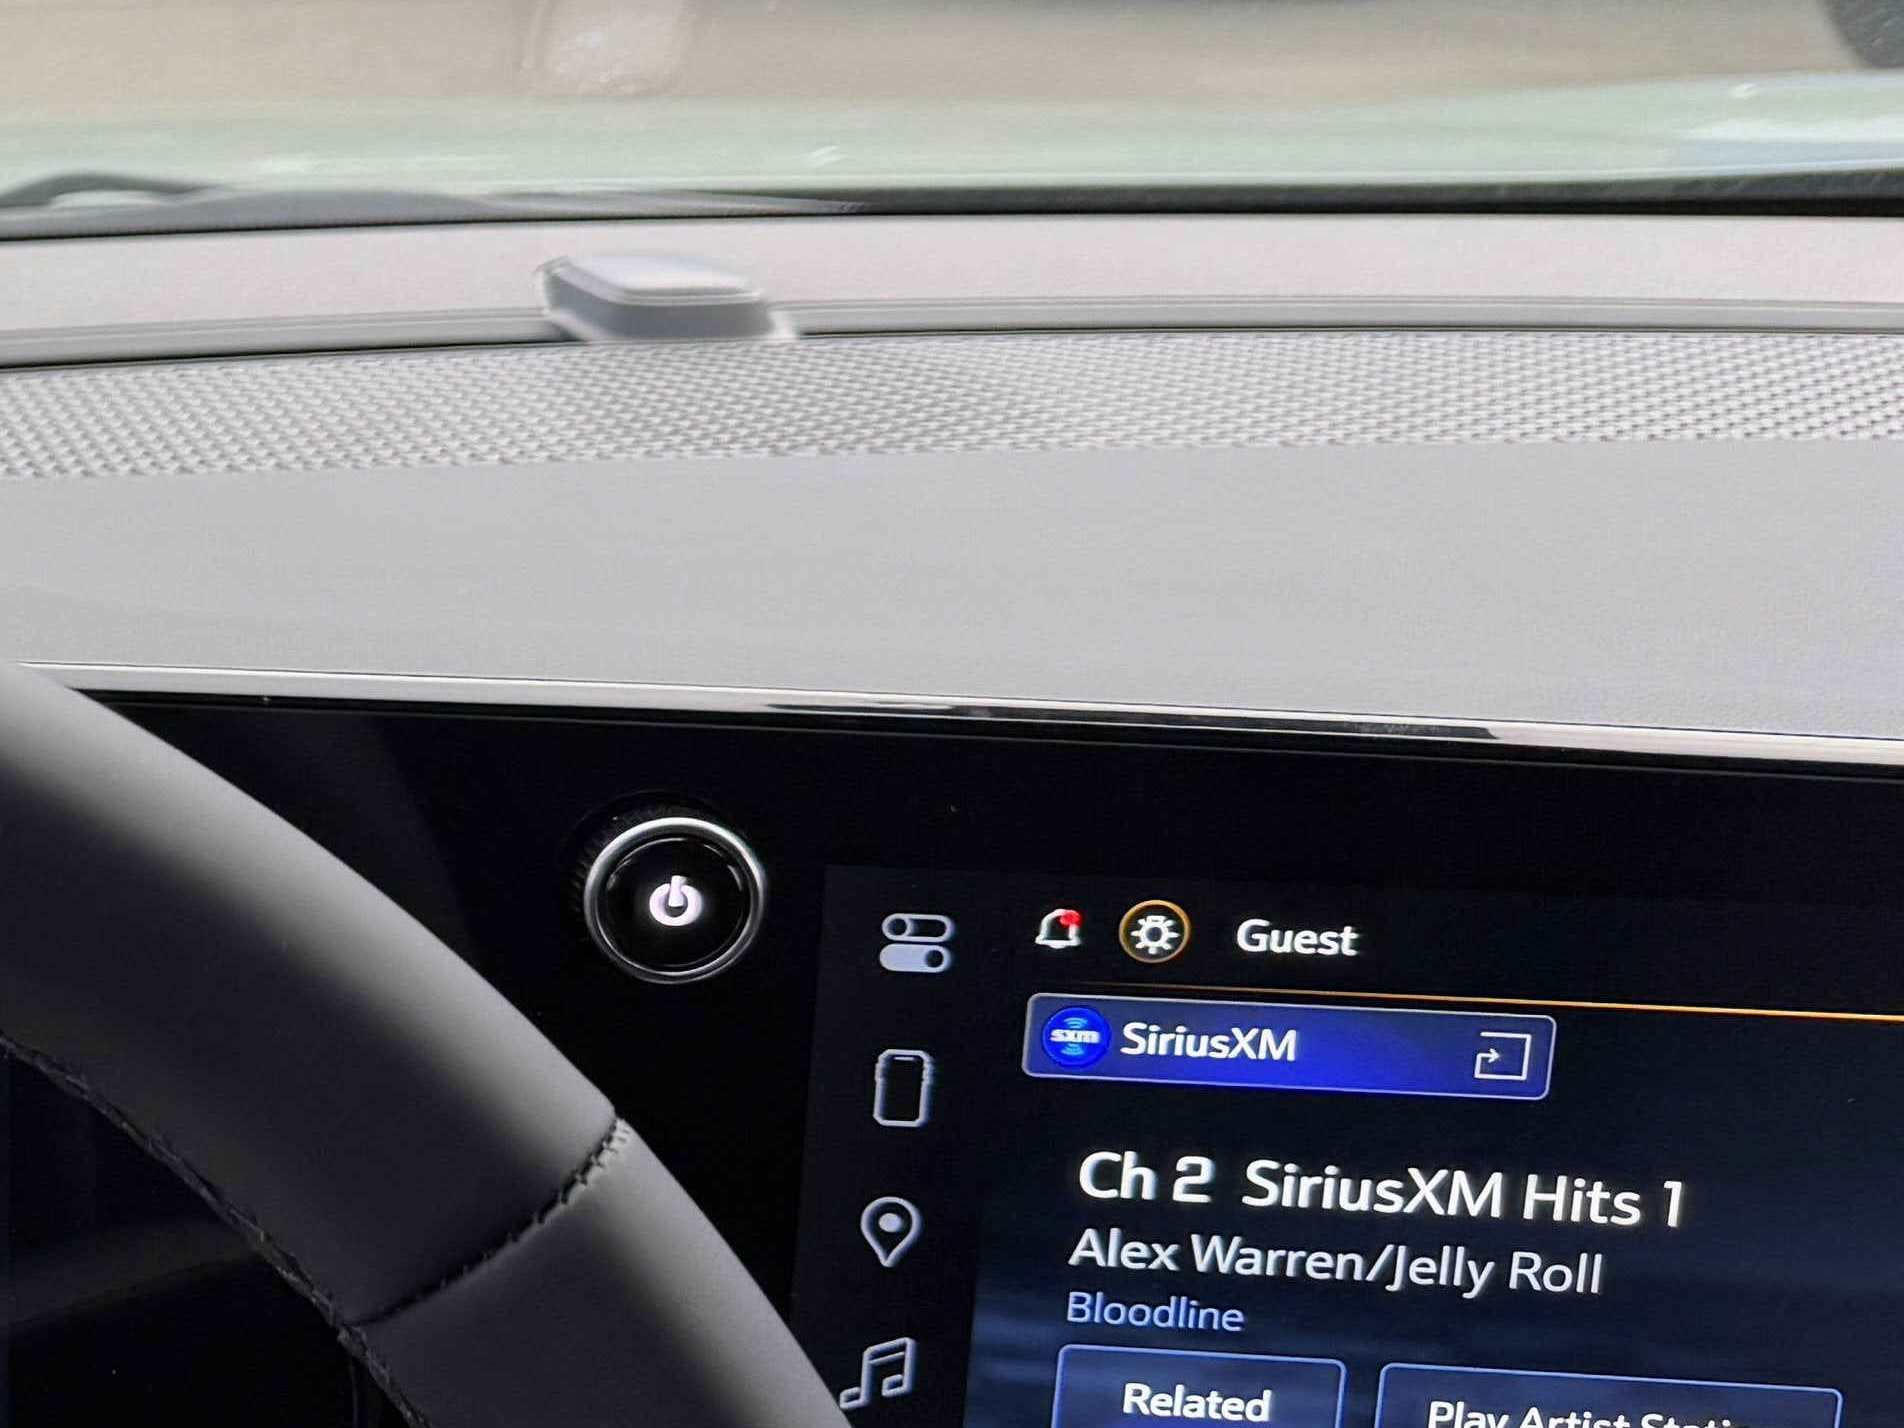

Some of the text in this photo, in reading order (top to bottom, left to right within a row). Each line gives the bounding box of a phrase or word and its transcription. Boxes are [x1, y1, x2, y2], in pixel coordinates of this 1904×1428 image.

[1237, 919, 1361, 957] Guest
[1120, 1022, 1298, 1062] SiriusXM
[1078, 1149, 1685, 1229] Ch 2 SiriusXM Hits 1
[1068, 1227, 1602, 1298] Alex Warren/Jelly Roll
[1066, 1291, 1245, 1334] Bloodline
[1122, 1381, 1272, 1424] Related
